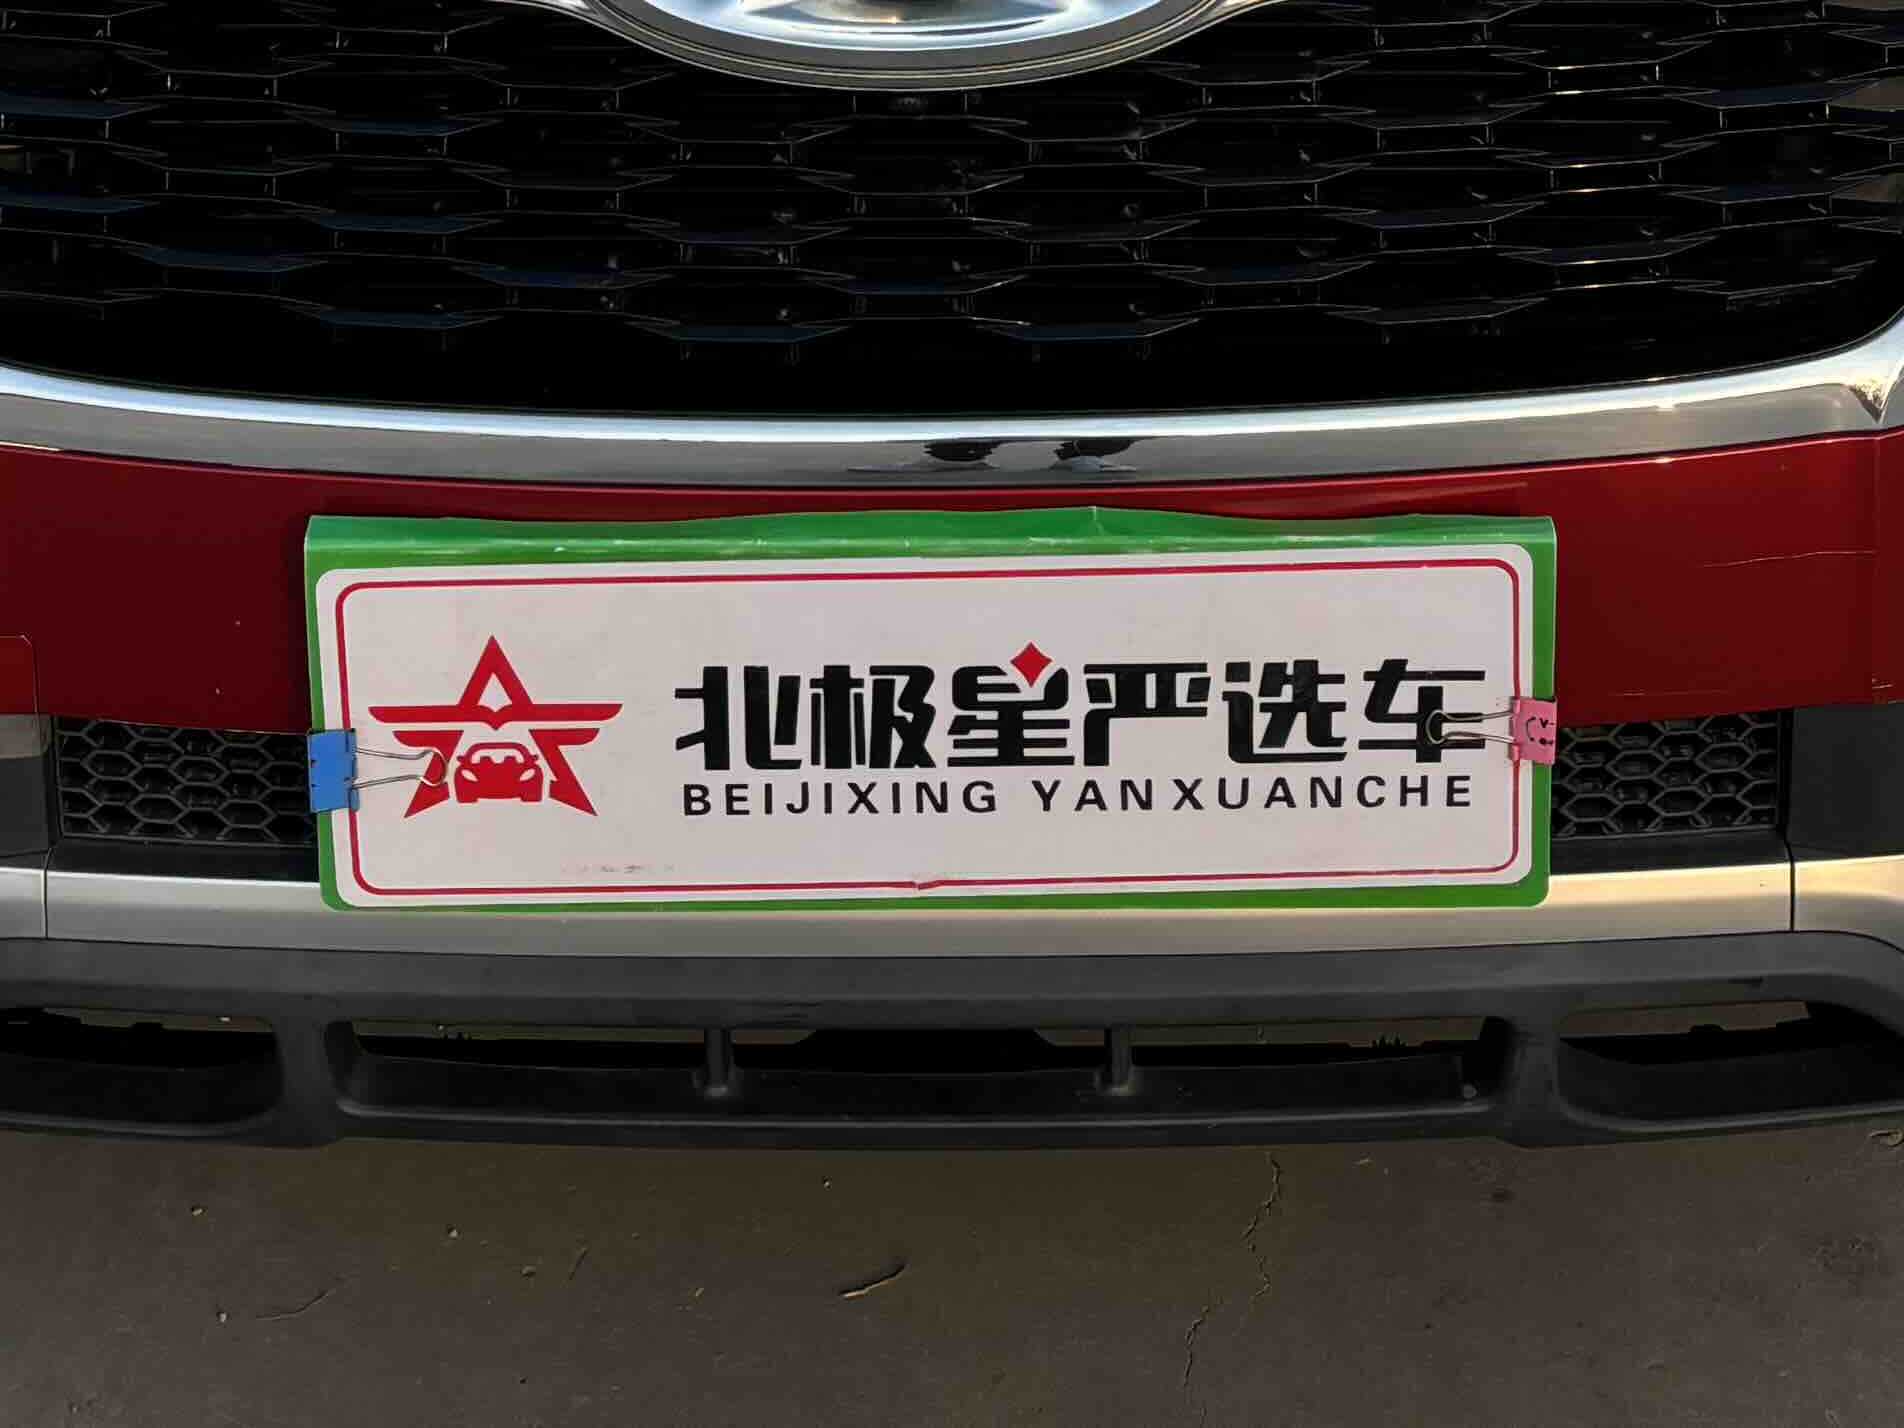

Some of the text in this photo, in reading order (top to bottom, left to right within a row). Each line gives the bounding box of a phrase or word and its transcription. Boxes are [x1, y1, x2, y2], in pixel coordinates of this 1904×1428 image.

[674, 641, 1486, 771] 北极星严选车
[683, 774, 1472, 817] BEIJIXING YANXUANCHE
